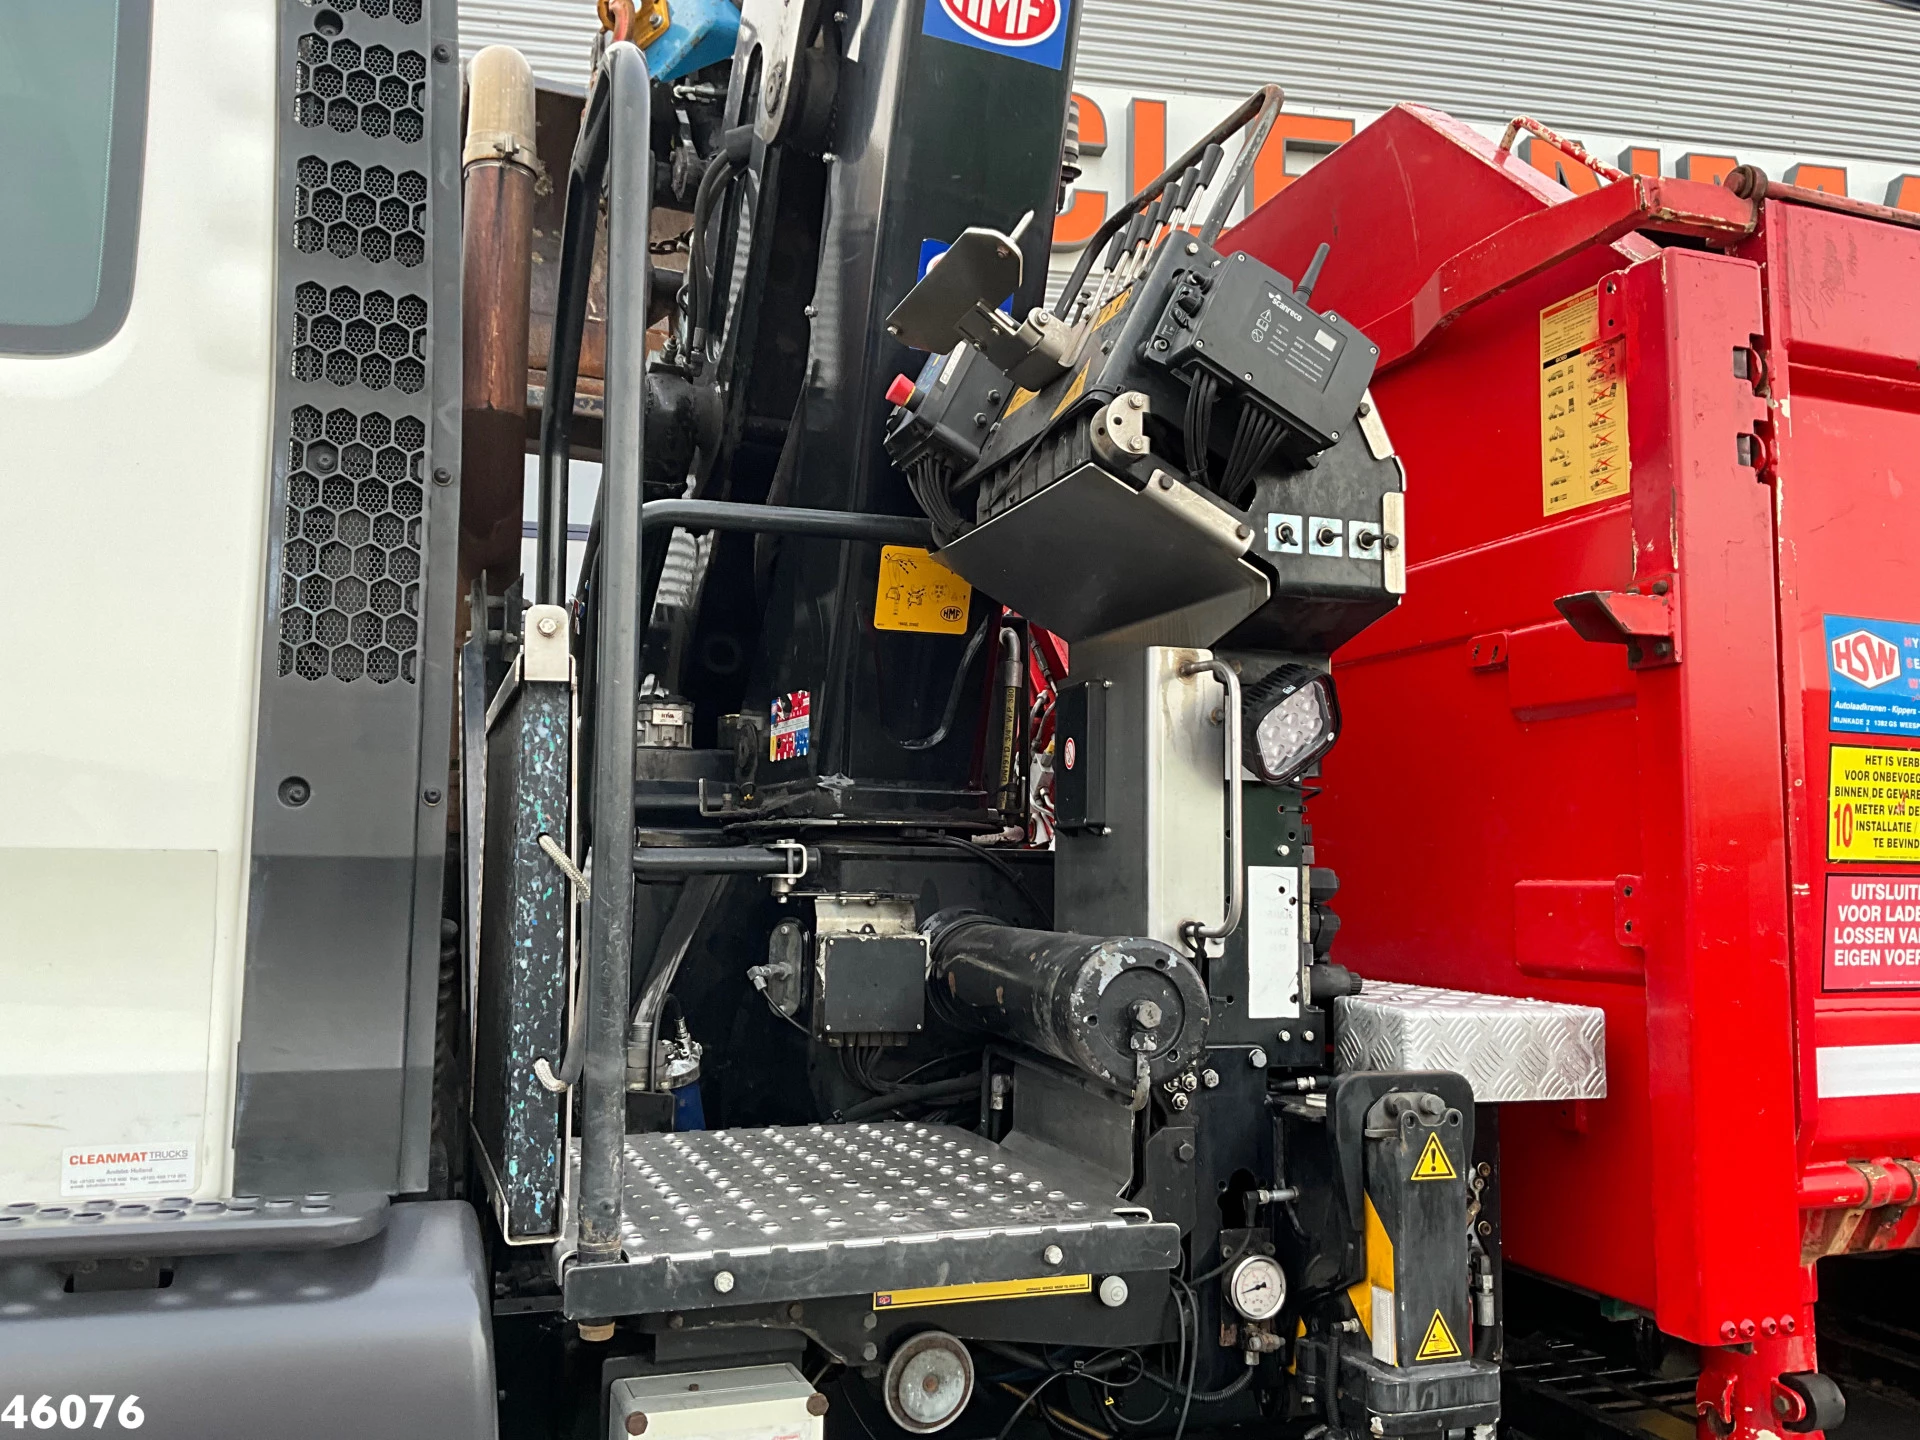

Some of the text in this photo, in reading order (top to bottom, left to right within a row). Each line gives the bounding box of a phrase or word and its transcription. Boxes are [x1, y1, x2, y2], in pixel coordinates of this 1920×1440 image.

[1272, 298, 1303, 322] scanreco
[943, 609, 960, 620] HMF
[1834, 634, 1896, 682] HSW
[1834, 701, 1886, 712] Autolaadkranen
[1892, 705, 1916, 716] Kippers
[1834, 716, 1864, 726] RIJNKADE
[1865, 755, 1920, 767] HET IS VERB
[1845, 770, 1869, 781] VOOR
[1835, 786, 1920, 800] BINNEN DE GEVARE
[1834, 803, 1920, 848] 10 METER VAN DE
[1856, 820, 1912, 832] INSTALLATIE
[1873, 838, 1920, 848] TE BEVIND
[1851, 884, 1920, 900] UITSLUIT
[1838, 905, 1881, 922] VOOR
[1834, 927, 1920, 944] LOSSEN VA
[1834, 949, 1880, 966] EIGEN
[69, 1150, 188, 1166] CLEANMAT TRUCKS
